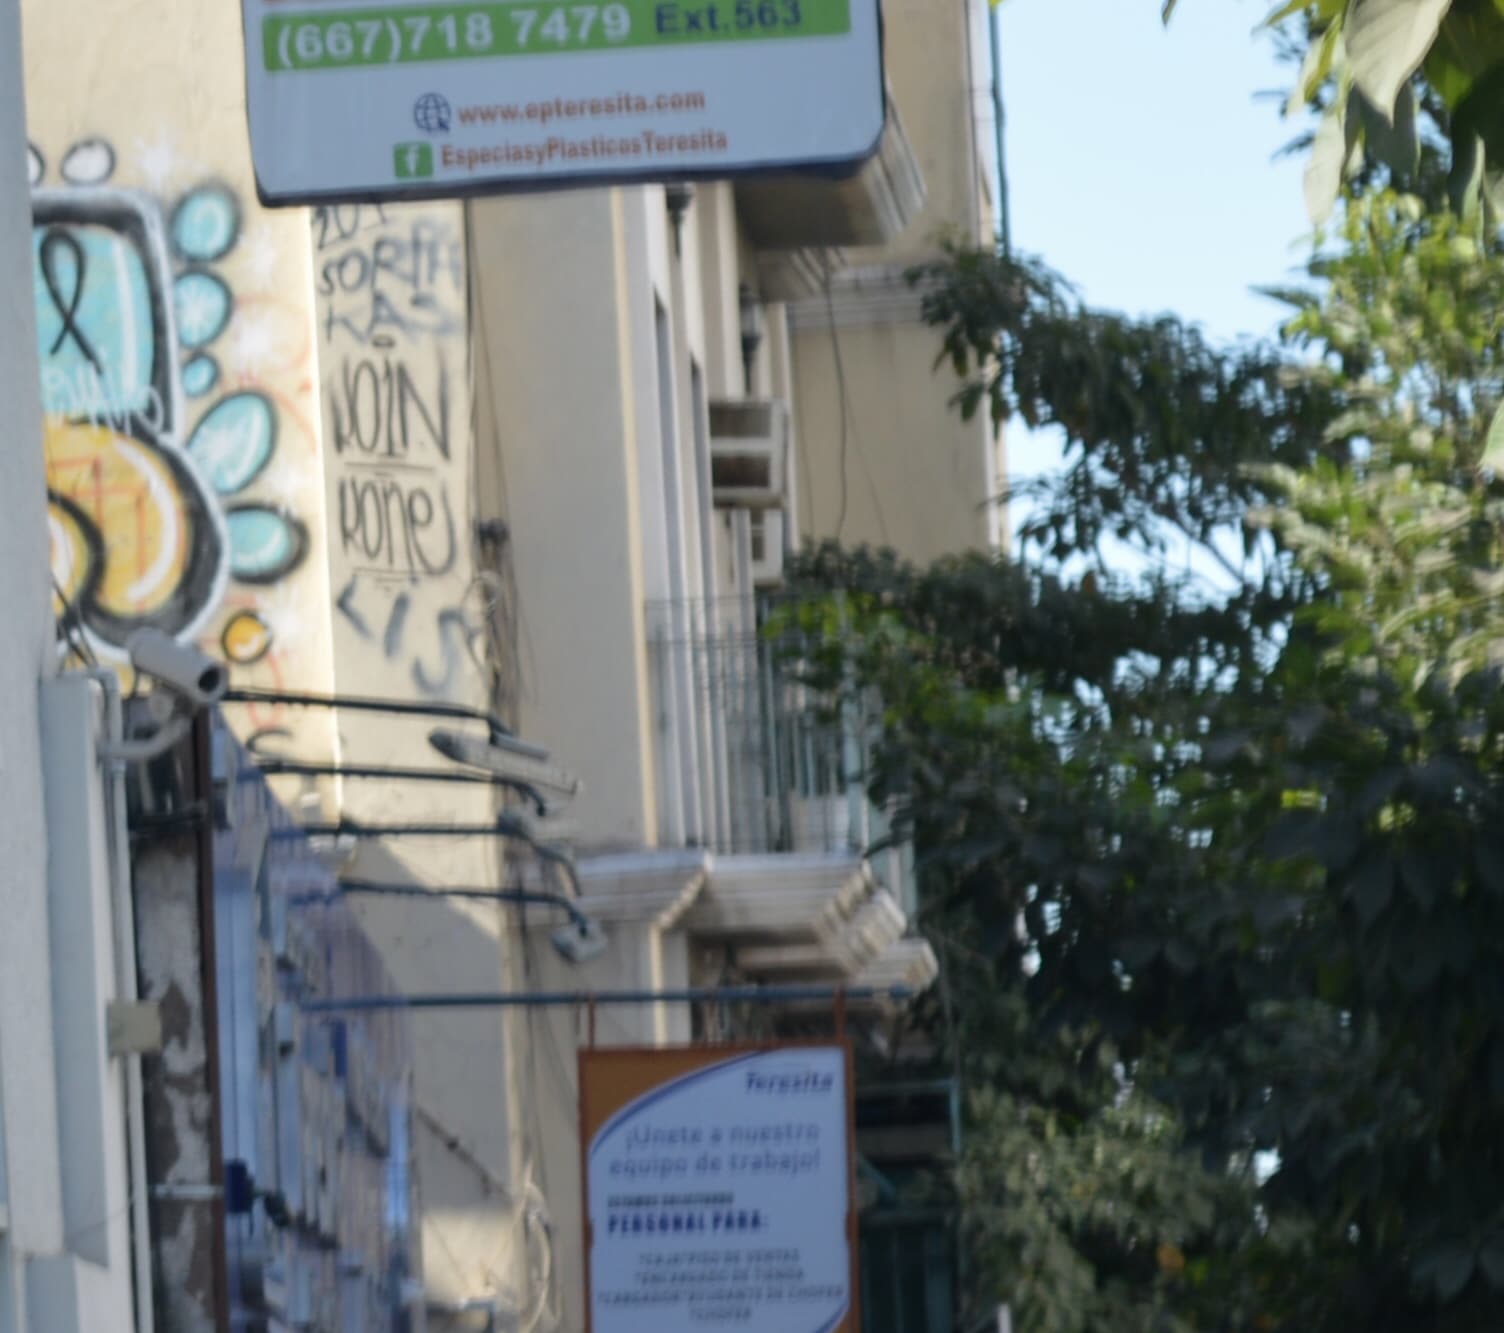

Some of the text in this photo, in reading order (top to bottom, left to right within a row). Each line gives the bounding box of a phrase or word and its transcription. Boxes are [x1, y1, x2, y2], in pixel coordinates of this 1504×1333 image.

[278, 0, 803, 66] (667)718 7479 Ext.563
[458, 90, 706, 125] www.epteresita.com
[441, 129, 729, 170] EspeciasyPlasticosTeresita
[729, 1122, 821, 1144] nuestro
[609, 1147, 821, 1182] equipo de trabajo!
[608, 1212, 705, 1236] PERSONAL
